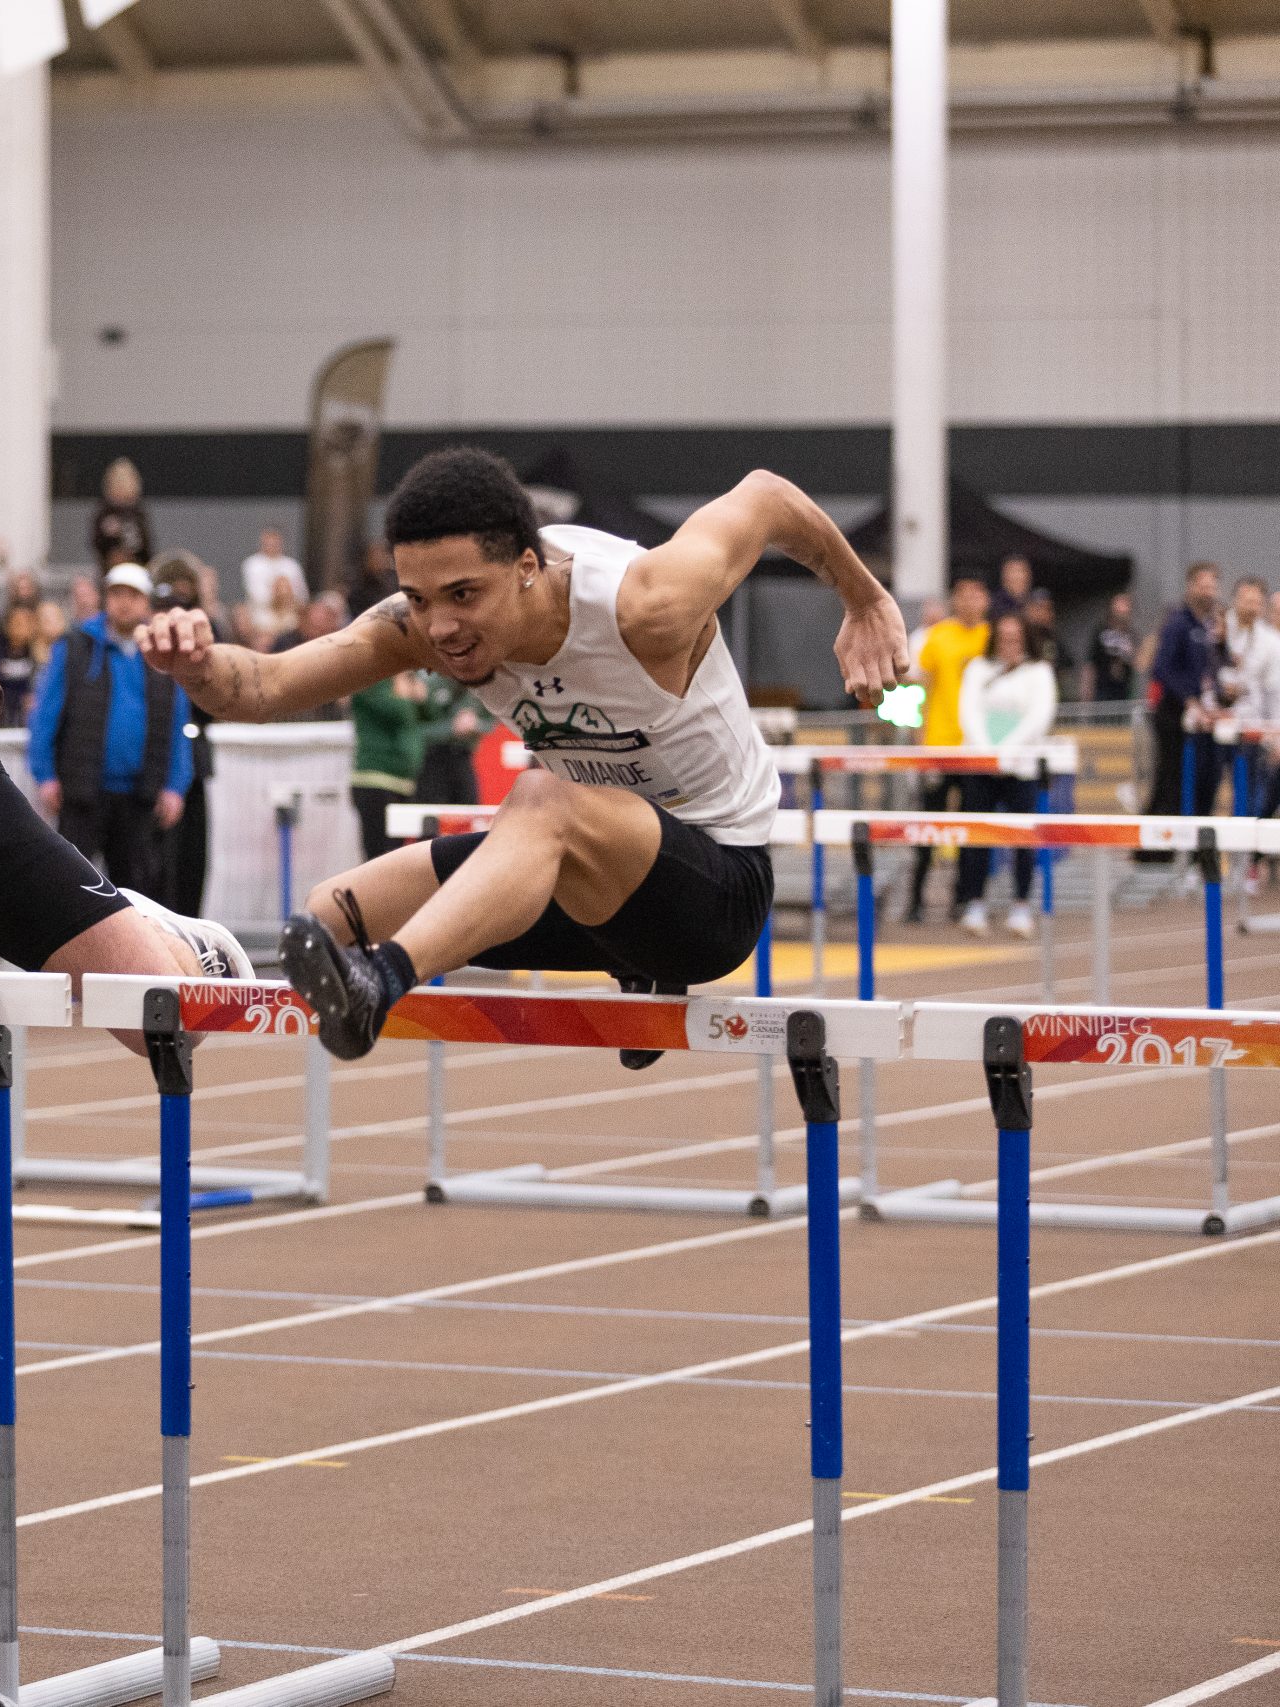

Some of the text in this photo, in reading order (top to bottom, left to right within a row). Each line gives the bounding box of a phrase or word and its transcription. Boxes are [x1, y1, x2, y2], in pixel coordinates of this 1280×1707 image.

[562, 758, 652, 786] DIMANDE
[181, 984, 292, 1007] WINNIPEG
[1026, 1015, 1152, 1037] WINNIPEG
[1096, 1033, 1233, 1067] 2017
